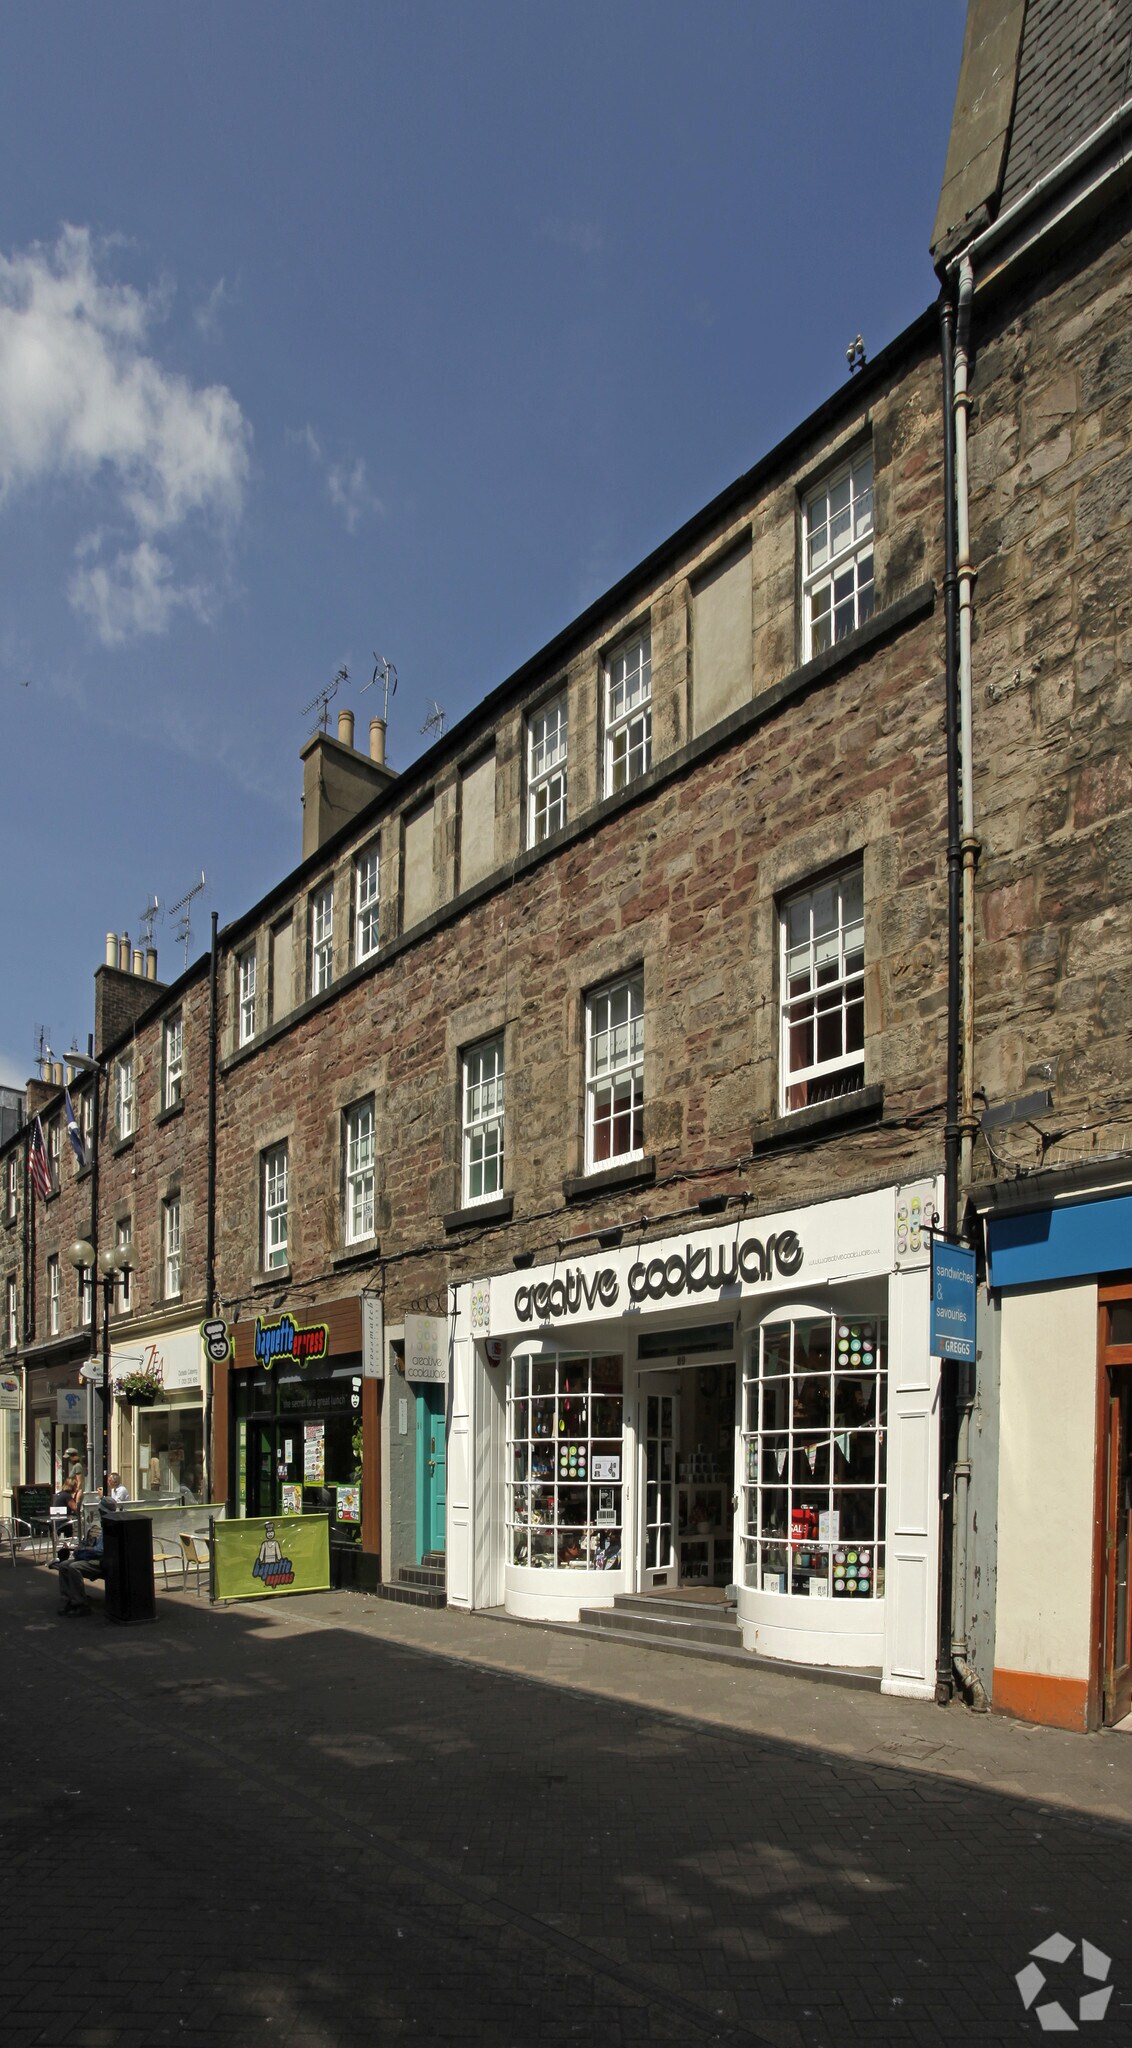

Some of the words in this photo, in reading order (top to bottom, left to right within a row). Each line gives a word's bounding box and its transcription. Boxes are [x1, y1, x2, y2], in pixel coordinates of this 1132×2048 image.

[514, 1266, 619, 1322] creative
[627, 1230, 804, 1302] cookware
[936, 1265, 974, 1284] sandwiches
[936, 1283, 943, 1300] &
[936, 1306, 967, 1322] savouries
[255, 1317, 294, 1364] baguette
[292, 1327, 325, 1364] express
[945, 1340, 970, 1355] GREGGS
[412, 1356, 442, 1367] creative
[408, 1368, 447, 1379] cookware
[253, 1559, 291, 1580] baguette
[265, 1572, 294, 1588] express
